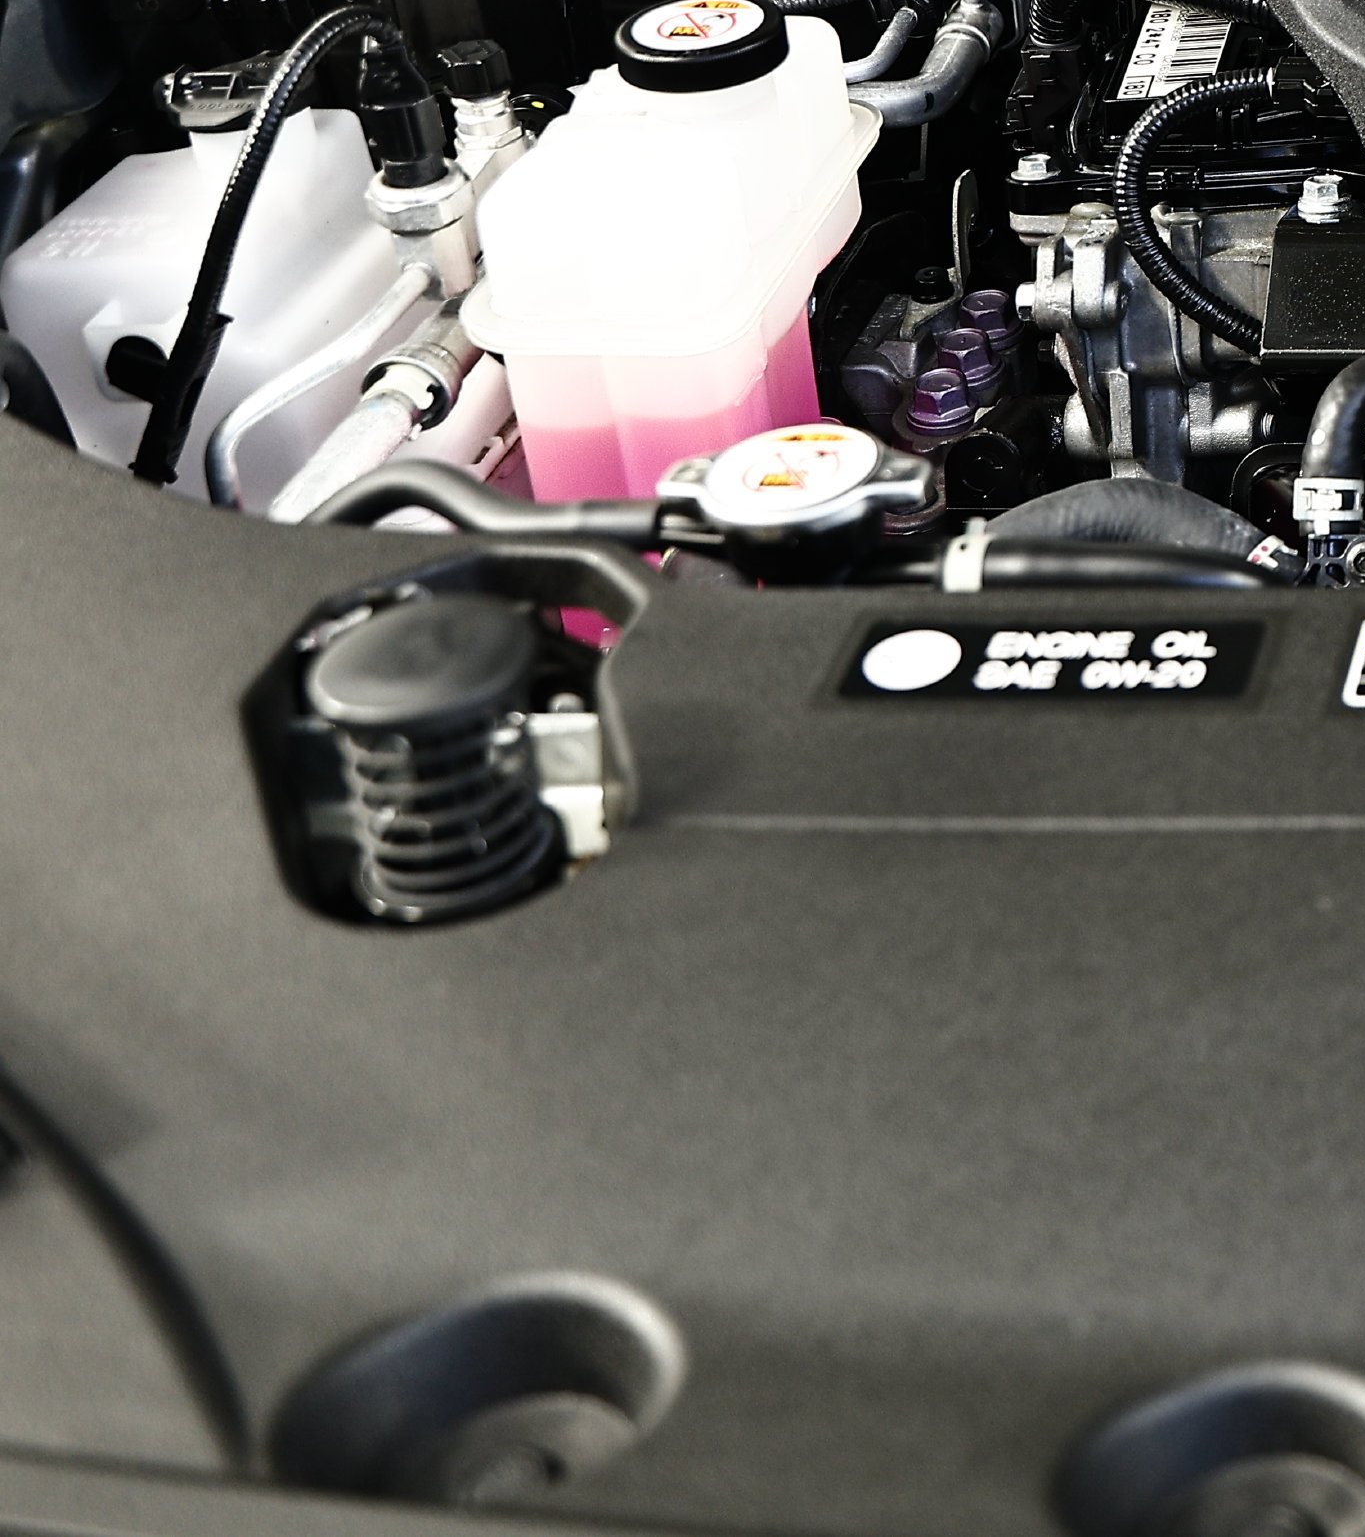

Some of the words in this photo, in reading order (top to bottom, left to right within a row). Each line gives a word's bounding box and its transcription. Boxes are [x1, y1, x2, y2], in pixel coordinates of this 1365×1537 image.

[1149, 9, 1172, 24] 180
[1122, 80, 1146, 96] 180
[985, 630, 1135, 659] ENGINE
[1151, 630, 1218, 659] OIL
[972, 660, 1062, 690] SAE
